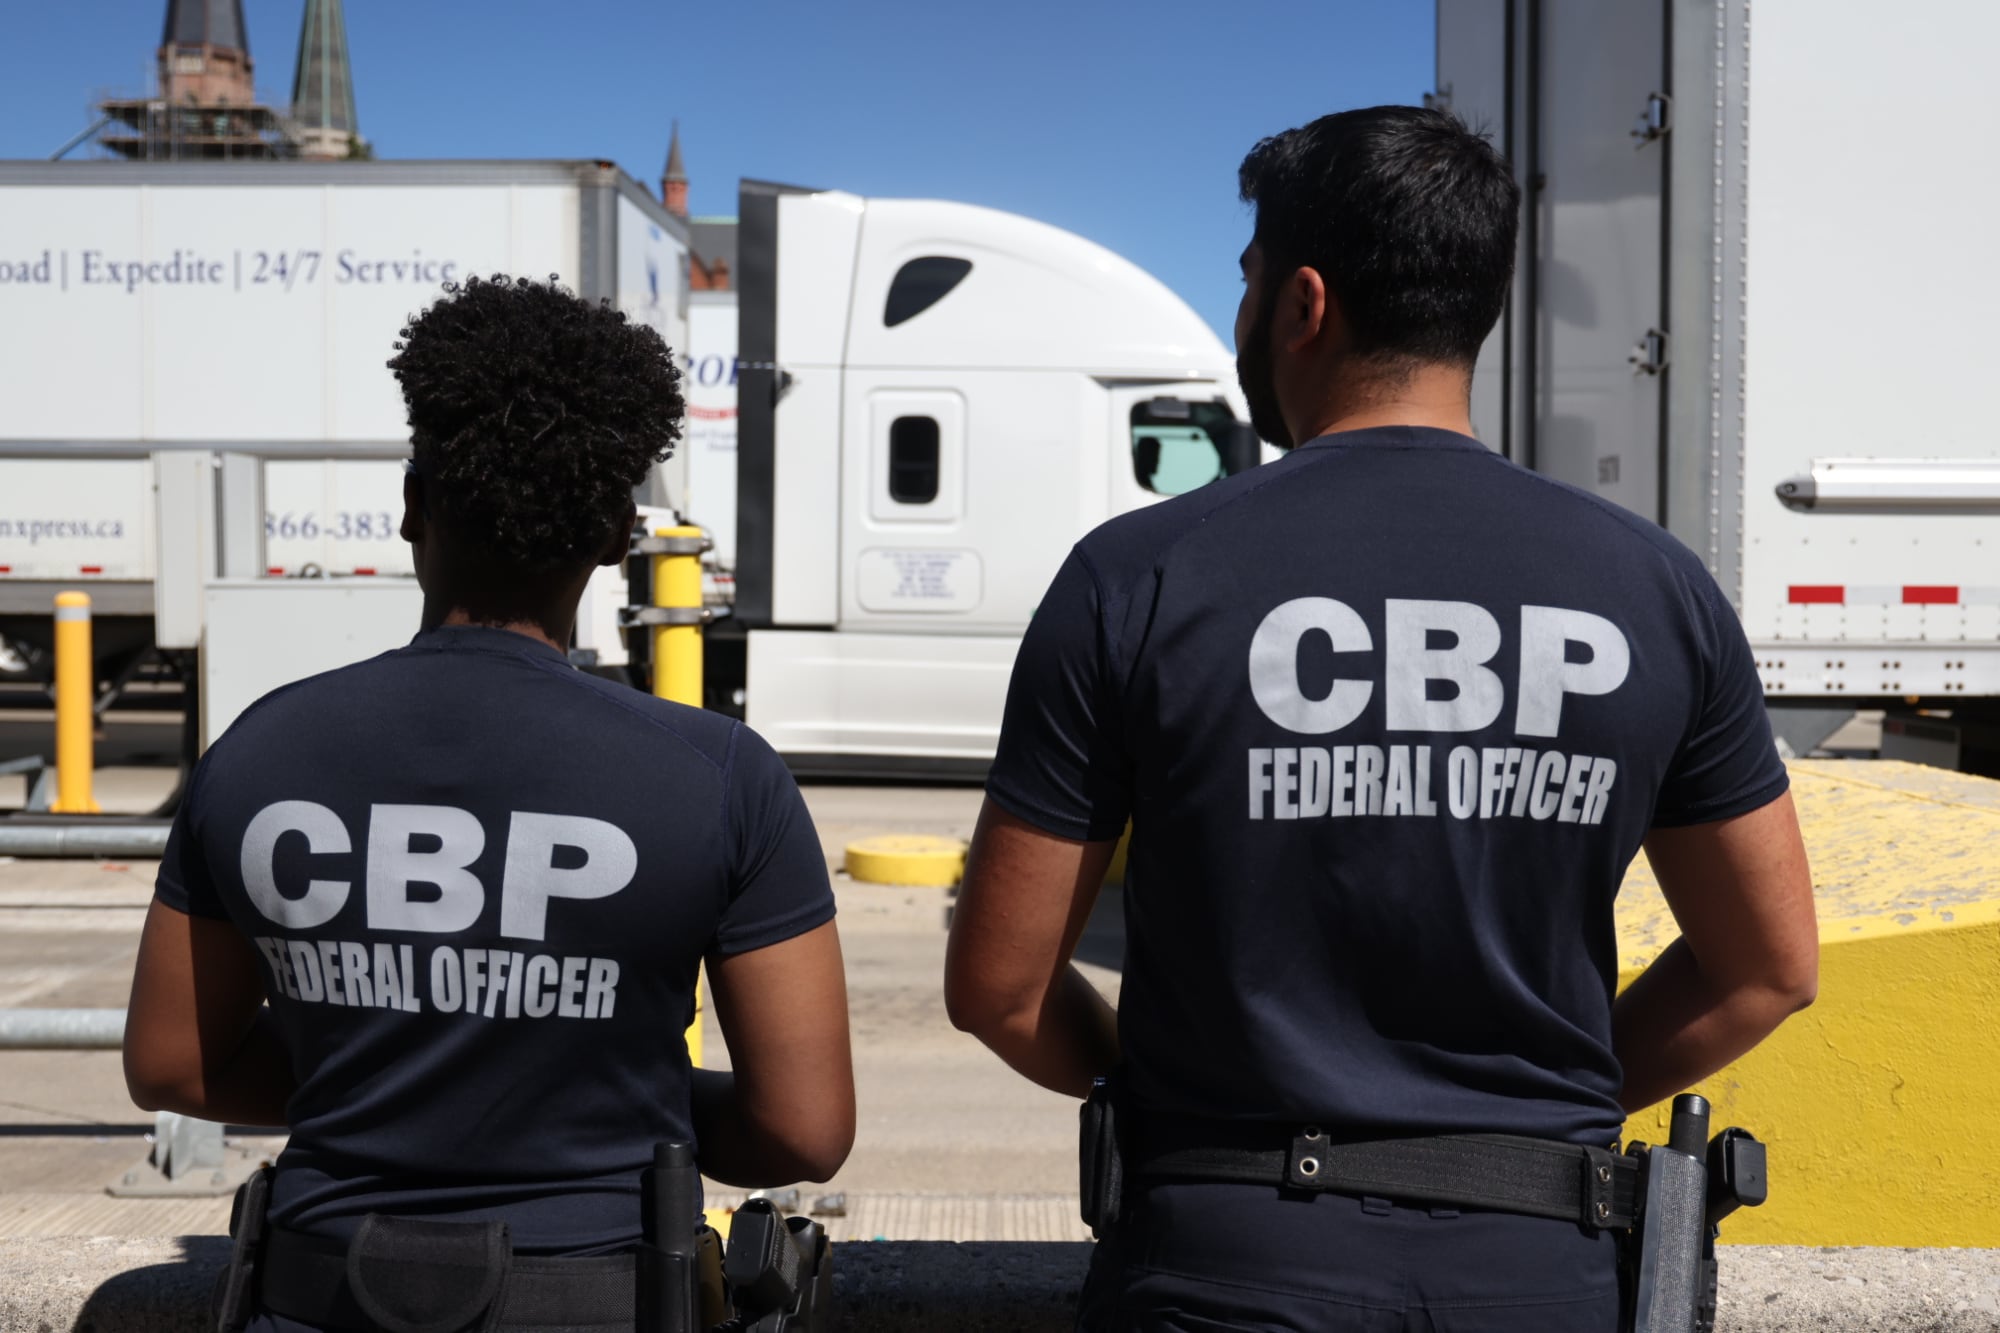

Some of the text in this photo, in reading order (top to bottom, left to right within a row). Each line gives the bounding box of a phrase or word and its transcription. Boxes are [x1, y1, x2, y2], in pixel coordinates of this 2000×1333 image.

[82, 249, 224, 293] Expedite
[252, 250, 321, 292] 24/7
[335, 249, 457, 283] Service
[1248, 596, 1631, 738] CBP
[1248, 745, 1617, 825] FEDERAL OFFICER
[240, 799, 639, 942] CBP
[254, 936, 620, 1019] FEDERAL OFFICER
